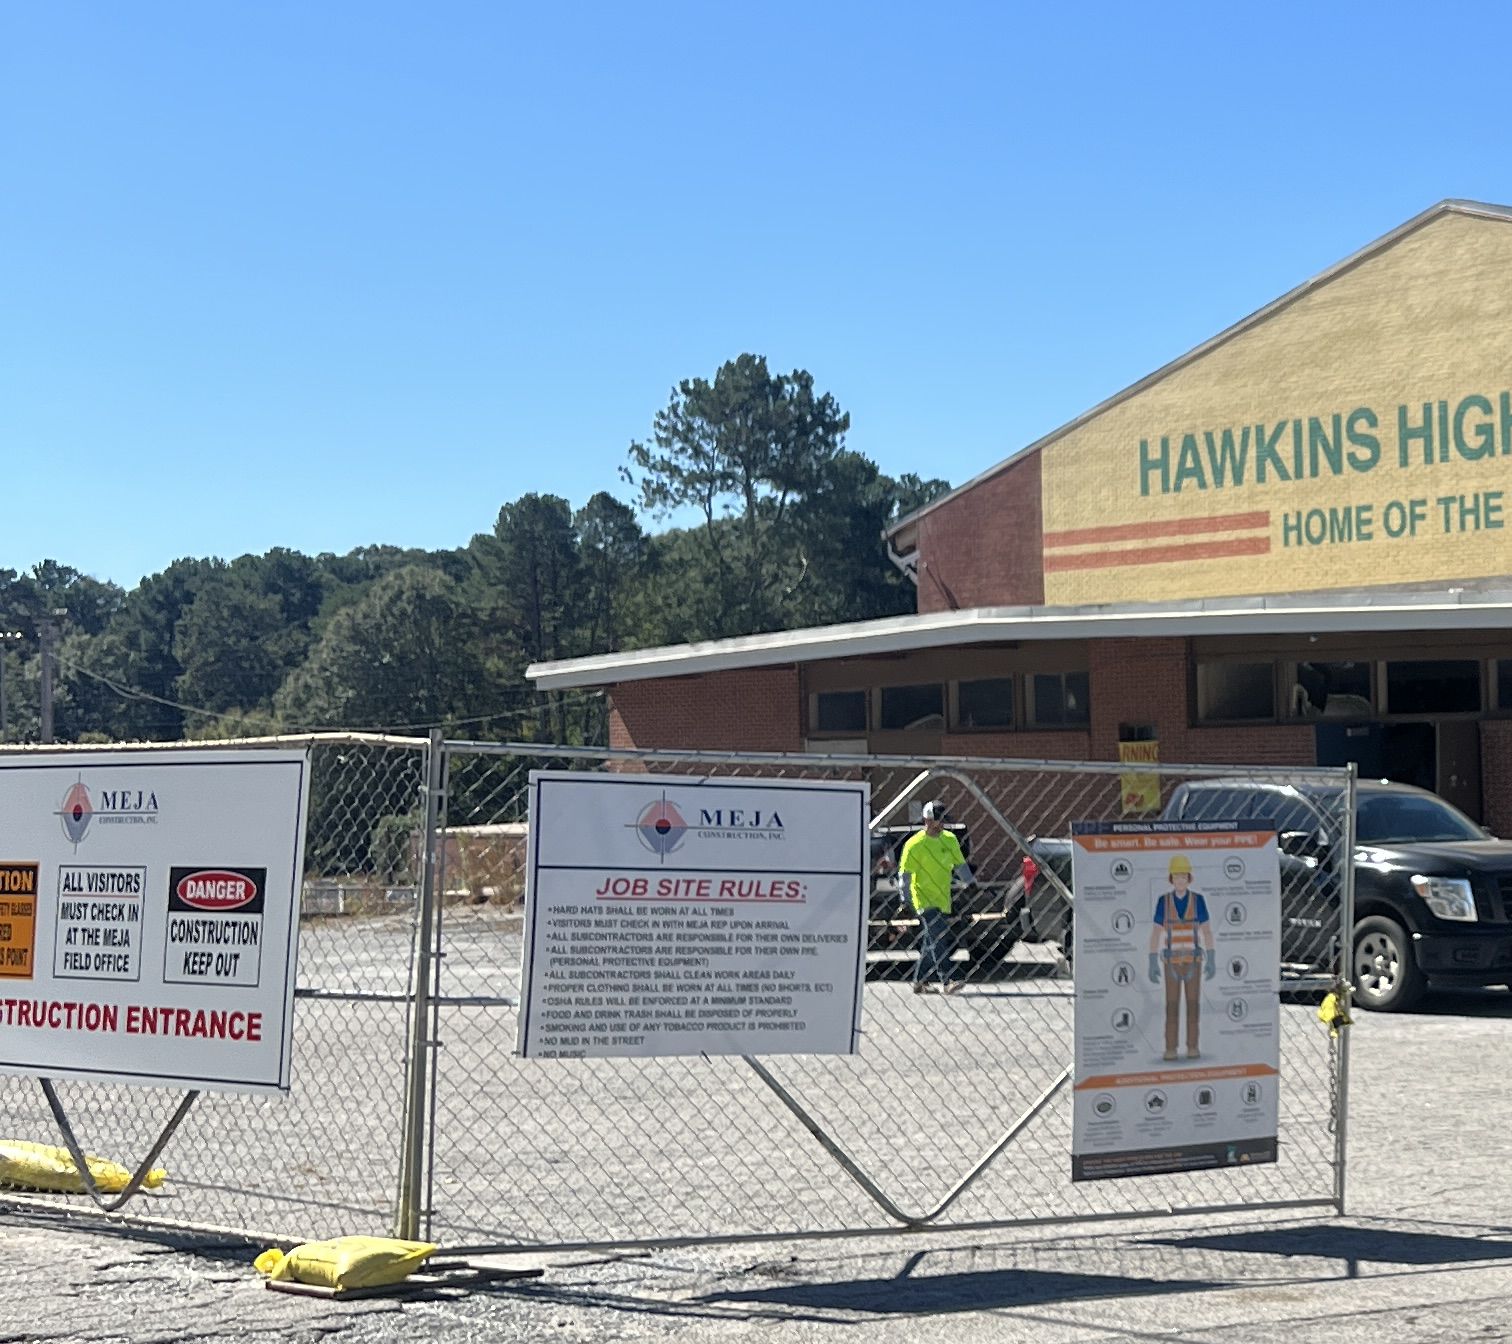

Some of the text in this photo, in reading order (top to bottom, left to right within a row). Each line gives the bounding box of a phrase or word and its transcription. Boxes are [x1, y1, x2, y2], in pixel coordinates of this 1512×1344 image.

[1139, 407, 1382, 497] HAWKINS
[1282, 502, 1374, 548] HOME
[1383, 500, 1428, 538] OF
[1437, 492, 1503, 535] THE
[101, 790, 159, 811] MEJA
[699, 809, 784, 828] MEJA
[1113, 822, 1238, 832] PERSONAL PROTECTIVE EQUIPMENT
[1094, 838, 1108, 848] Be
[1111, 838, 1140, 848] smart.
[1144, 837, 1157, 847] Be
[1184, 837, 1210, 846] Wear
[1211, 837, 1232, 847] your
[63, 872, 140, 894] ALL VISITORS
[186, 880, 246, 900] DANGER
[596, 878, 808, 899] JOB SITE RULES:
[61, 903, 139, 922] MUST CHECK IN
[552, 906, 734, 917] HARD HATS SHALL BE WORN AT ALL TIMES
[552, 919, 790, 930] VISITORS MUST CHECK IN WITH MEJA REP UPON ARRIVAL
[66, 928, 130, 948] AT THE MEJA
[170, 920, 258, 946] CONSTRUCTION
[550, 933, 568, 942] ALL
[570, 933, 654, 942] SUBCONTRACTORS
[656, 933, 674, 942] ARE
[676, 934, 734, 943] RESPONSIBLE
[736, 934, 753, 943] FOR
[755, 934, 778, 943] THEIR
[780, 934, 800, 943] OWN
[550, 946, 568, 955] ALL
[570, 946, 652, 955] SUBCONTRACTORS
[654, 946, 673, 955] ARE
[675, 947, 733, 955] RESPONSIBLE
[736, 947, 752, 955] FOR
[754, 947, 778, 955] THEIR
[780, 947, 800, 956] OWN
[64, 953, 129, 973] FIELD OFFICE
[183, 952, 240, 977] KEEP OUT
[602, 958, 656, 967] PROTECTIVE
[550, 971, 796, 979] ALL SUBCONTRACTORS SHALL CLEAN WORK AREAS DAILY
[548, 984, 584, 992] PROPER
[586, 984, 630, 992] CLOTHING
[632, 984, 660, 992] SHALL
[662, 984, 674, 992] BE
[676, 984, 702, 992] WORN
[704, 984, 715, 992] AT
[717, 984, 732, 992] ALL
[736, 984, 760, 992] TIMES
[547, 997, 572, 1005] OSHA
[574, 997, 603, 1005] RULES
[606, 997, 626, 1005] WILL
[628, 997, 640, 1005] BE
[642, 997, 688, 1005] ENFORCED
[690, 997, 701, 1005] AT
[704, 997, 709, 1005] A
[749, 997, 792, 1005] STANDARD
[0, 999, 262, 1041] TRUCTION ENTRANCE
[624, 1010, 653, 1018] TRASH
[654, 1010, 682, 1018] SHALL
[684, 1010, 696, 1018] BE
[698, 1010, 740, 1018] DISPOSED
[742, 1010, 753, 1018] OF
[544, 1023, 586, 1031] SMOKING
[588, 1023, 608, 1031] AND
[609, 1023, 626, 1031] USE
[628, 1023, 640, 1031] OF
[642, 1023, 661, 1031] ANY
[664, 1023, 704, 1031] TOBACCO
[706, 1022, 746, 1030] PRODUCT
[748, 1022, 756, 1030] IS
[544, 1036, 645, 1045] NO MUD IN THE STREET
